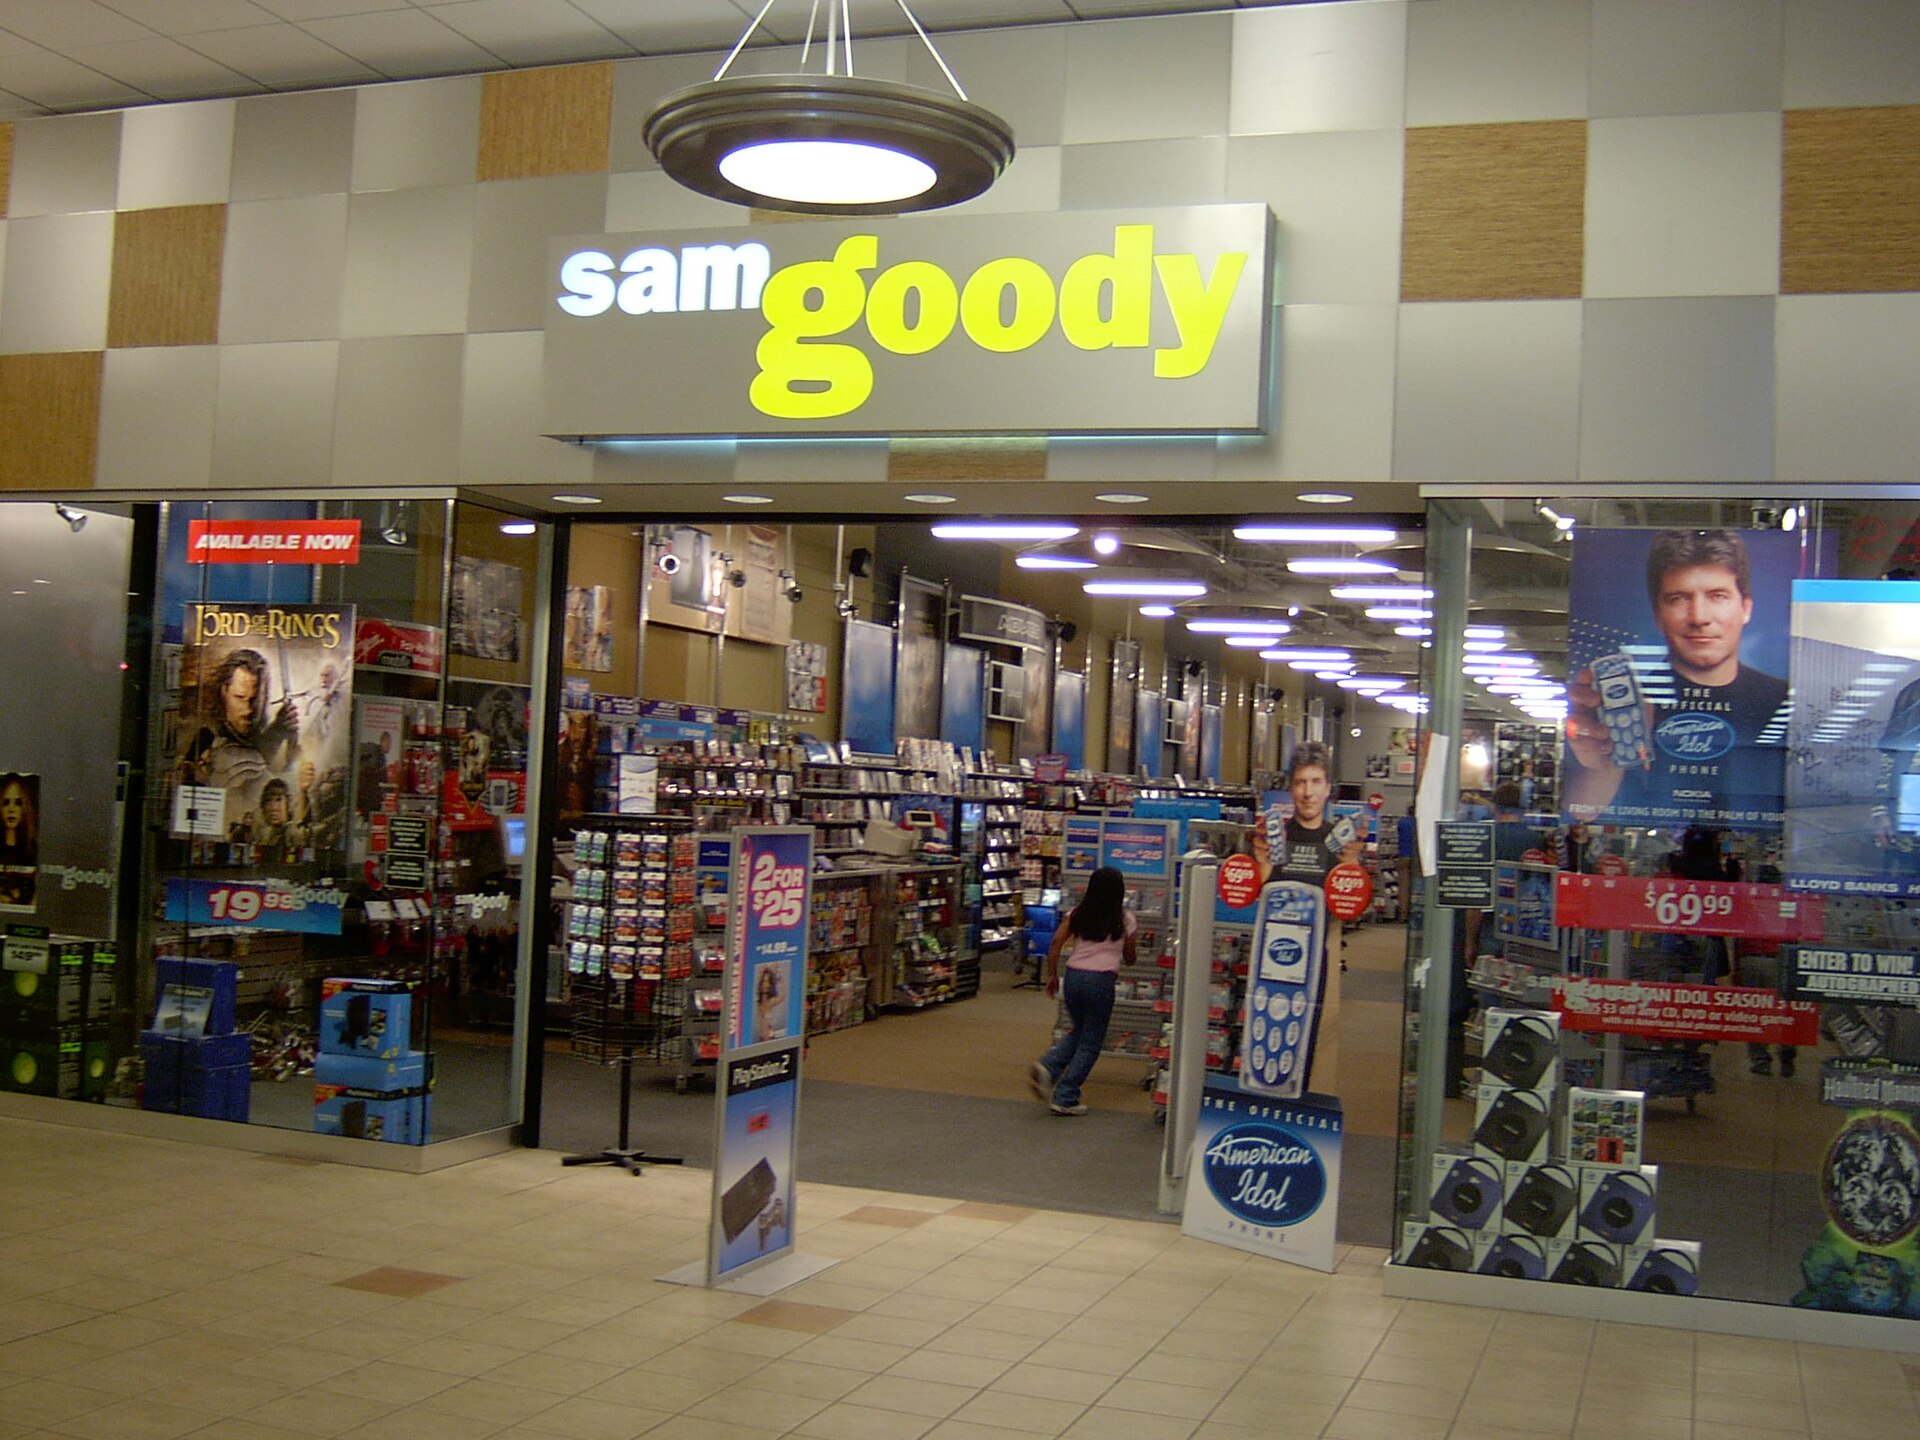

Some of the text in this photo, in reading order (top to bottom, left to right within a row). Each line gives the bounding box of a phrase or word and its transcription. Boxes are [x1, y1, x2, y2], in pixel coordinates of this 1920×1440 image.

[556, 225, 1249, 419] sam goody
[194, 534, 355, 550] AVAILABLE NOW
[193, 604, 251, 646] LORD
[267, 609, 341, 649] RINGS
[1682, 688, 1711, 698] THE
[1656, 719, 1725, 737] American
[1676, 735, 1713, 753] Idol
[1668, 765, 1719, 776] PHONE
[1671, 789, 1713, 799] NOKIA
[1568, 804, 1596, 814] FROM
[751, 854, 805, 891] 2 FOR
[1559, 876, 1617, 889] NOW
[1790, 879, 1840, 890] LLOYD
[1843, 881, 1899, 893] BANKS
[752, 888, 805, 927] $25
[1797, 949, 1914, 975] ENTER TO WIN!
[1806, 975, 1920, 995] AUTOGRAPHED
[1674, 988, 1710, 1006] IDOL
[1713, 991, 1774, 1009] SEASON
[1618, 1003, 1636, 1015] off
[1682, 1007, 1707, 1020] DVD
[1723, 1010, 1759, 1023] video
[1203, 1096, 1342, 1132] THE OFFICIAL
[1206, 1133, 1313, 1166] American
[1231, 1168, 1291, 1212] Idol
[1227, 1220, 1287, 1244] PHONE
